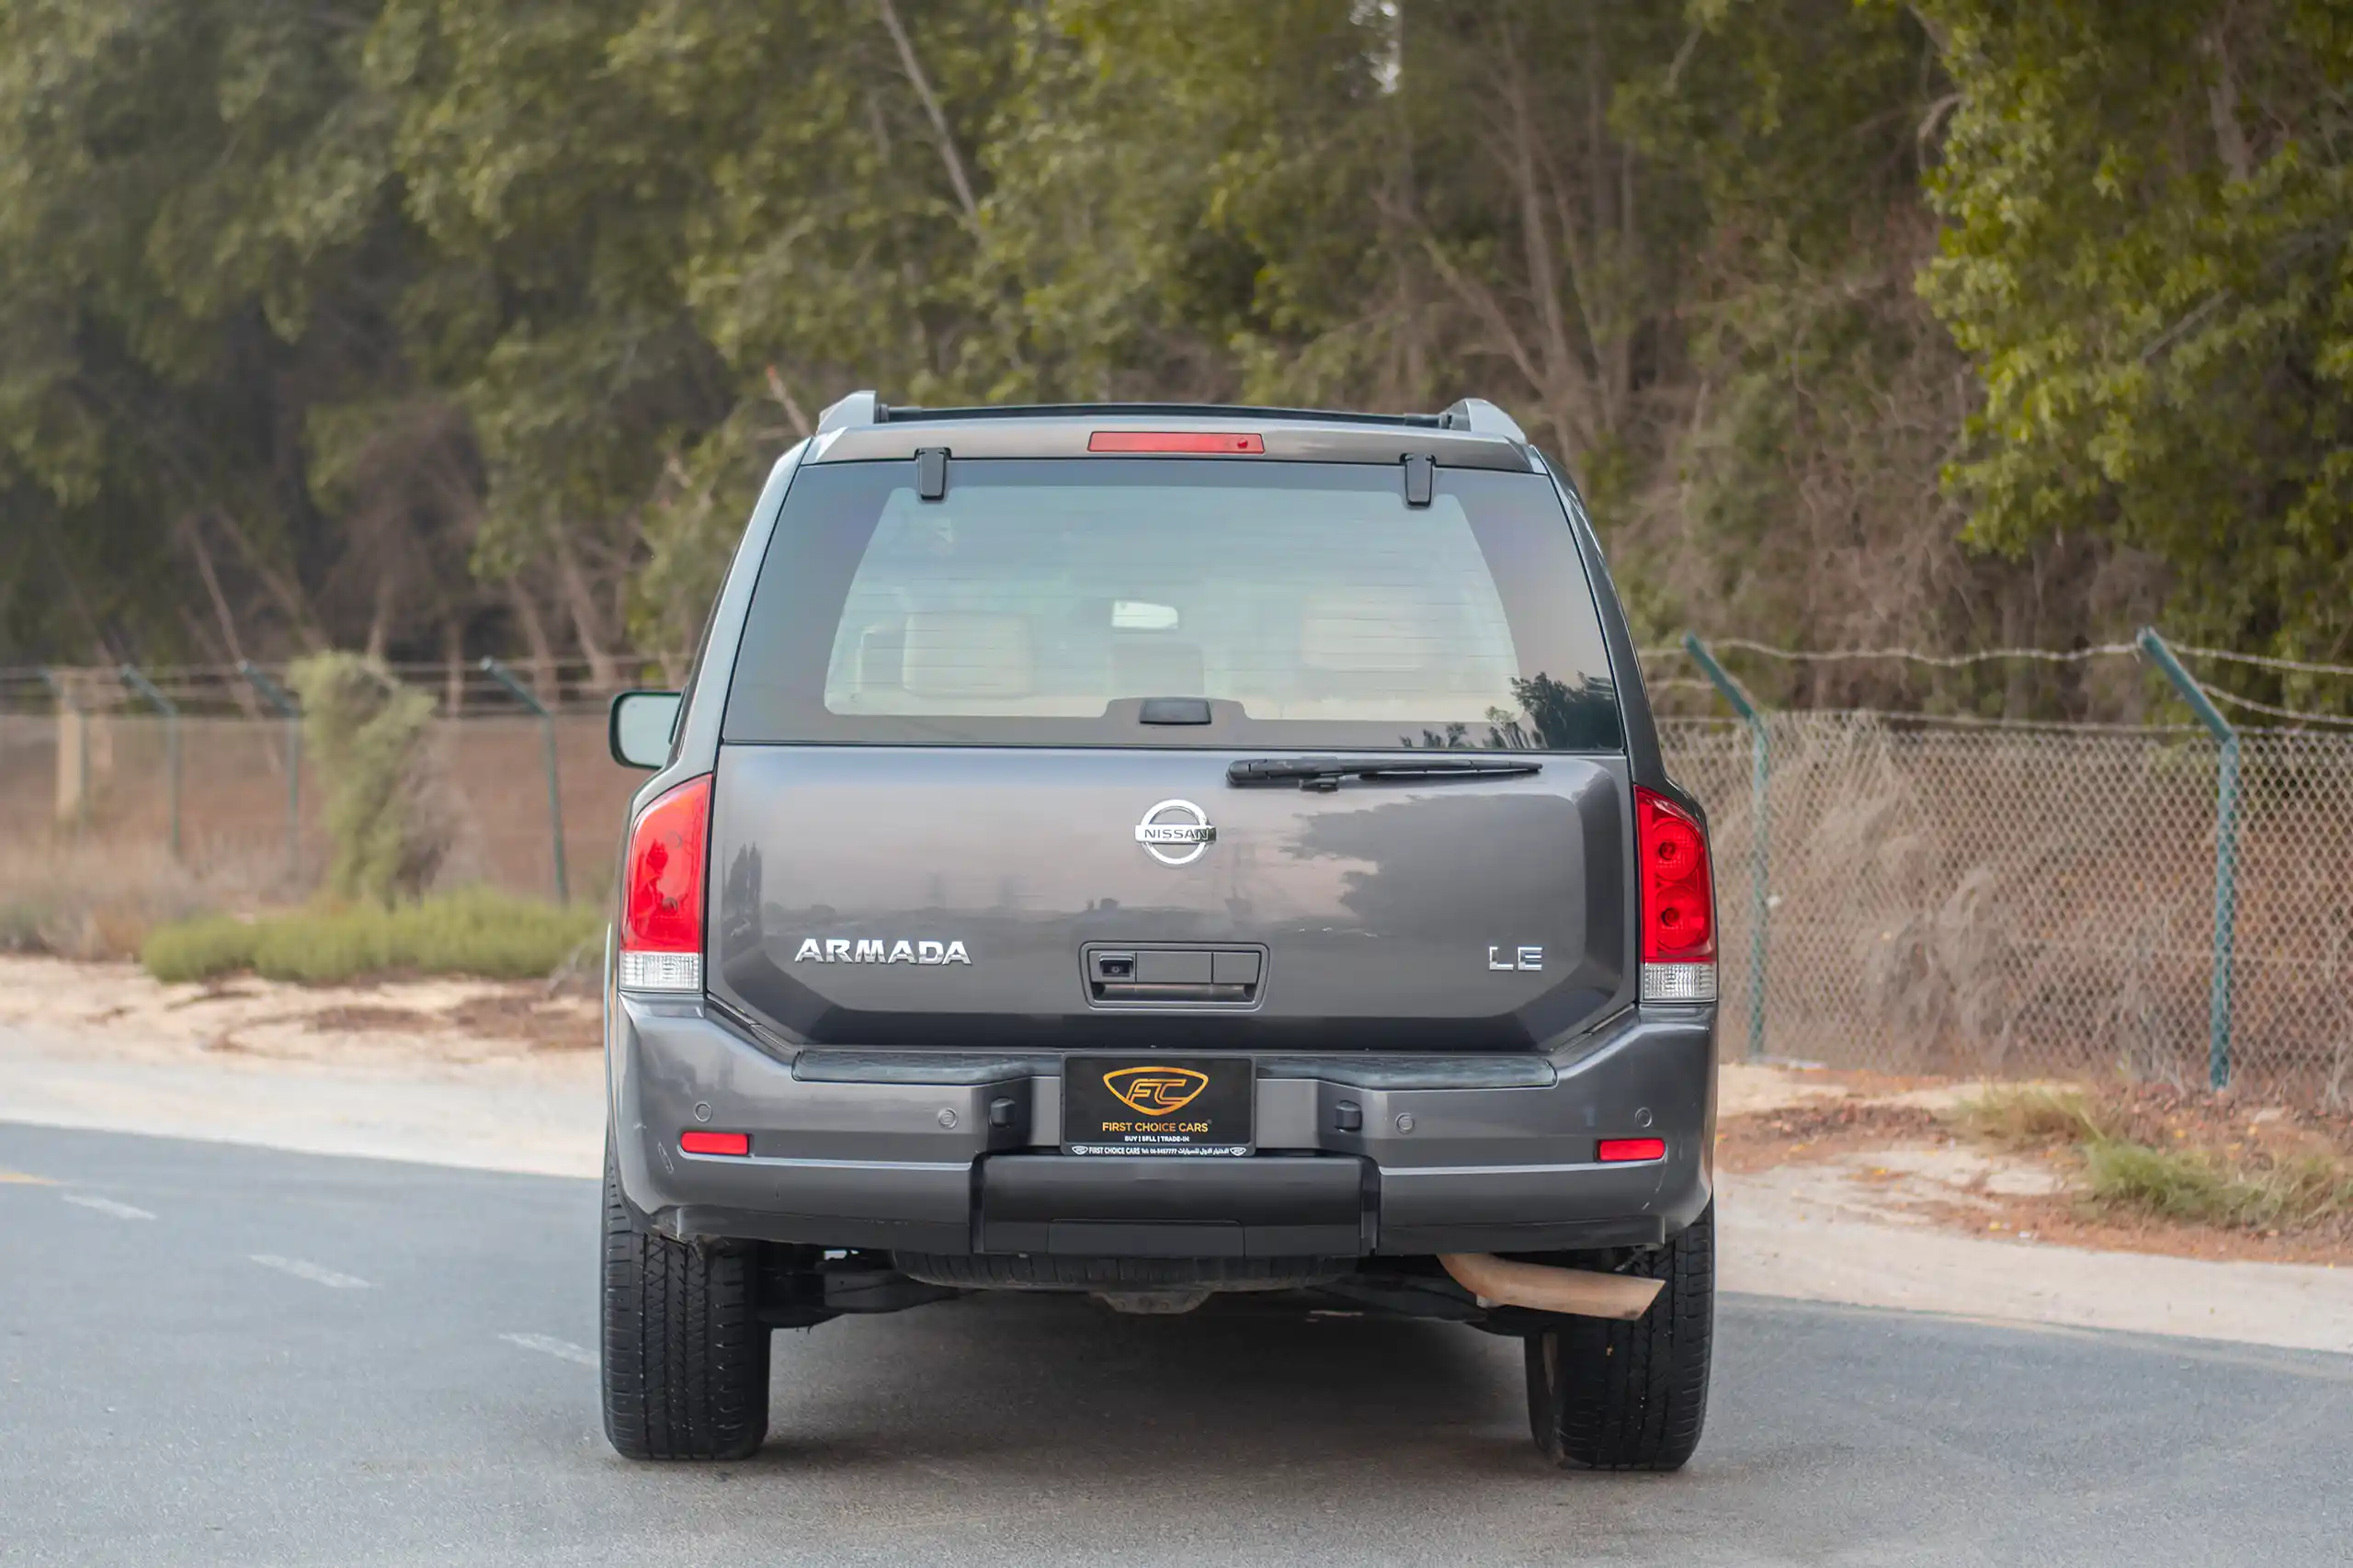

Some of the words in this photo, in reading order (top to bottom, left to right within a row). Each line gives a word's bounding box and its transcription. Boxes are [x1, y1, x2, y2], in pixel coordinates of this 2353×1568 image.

[1144, 828, 1209, 840] NISSAN
[794, 937, 972, 966] ARMADA
[1489, 946, 1543, 971] LE
[1102, 1121, 1132, 1132] FIRST
[1134, 1121, 1176, 1132] CHOICE
[1178, 1122, 1209, 1132] CARS
[1088, 1146, 1104, 1154] FIRST
[1104, 1146, 1126, 1154] CHOICE
[1126, 1146, 1141, 1154] CARS
